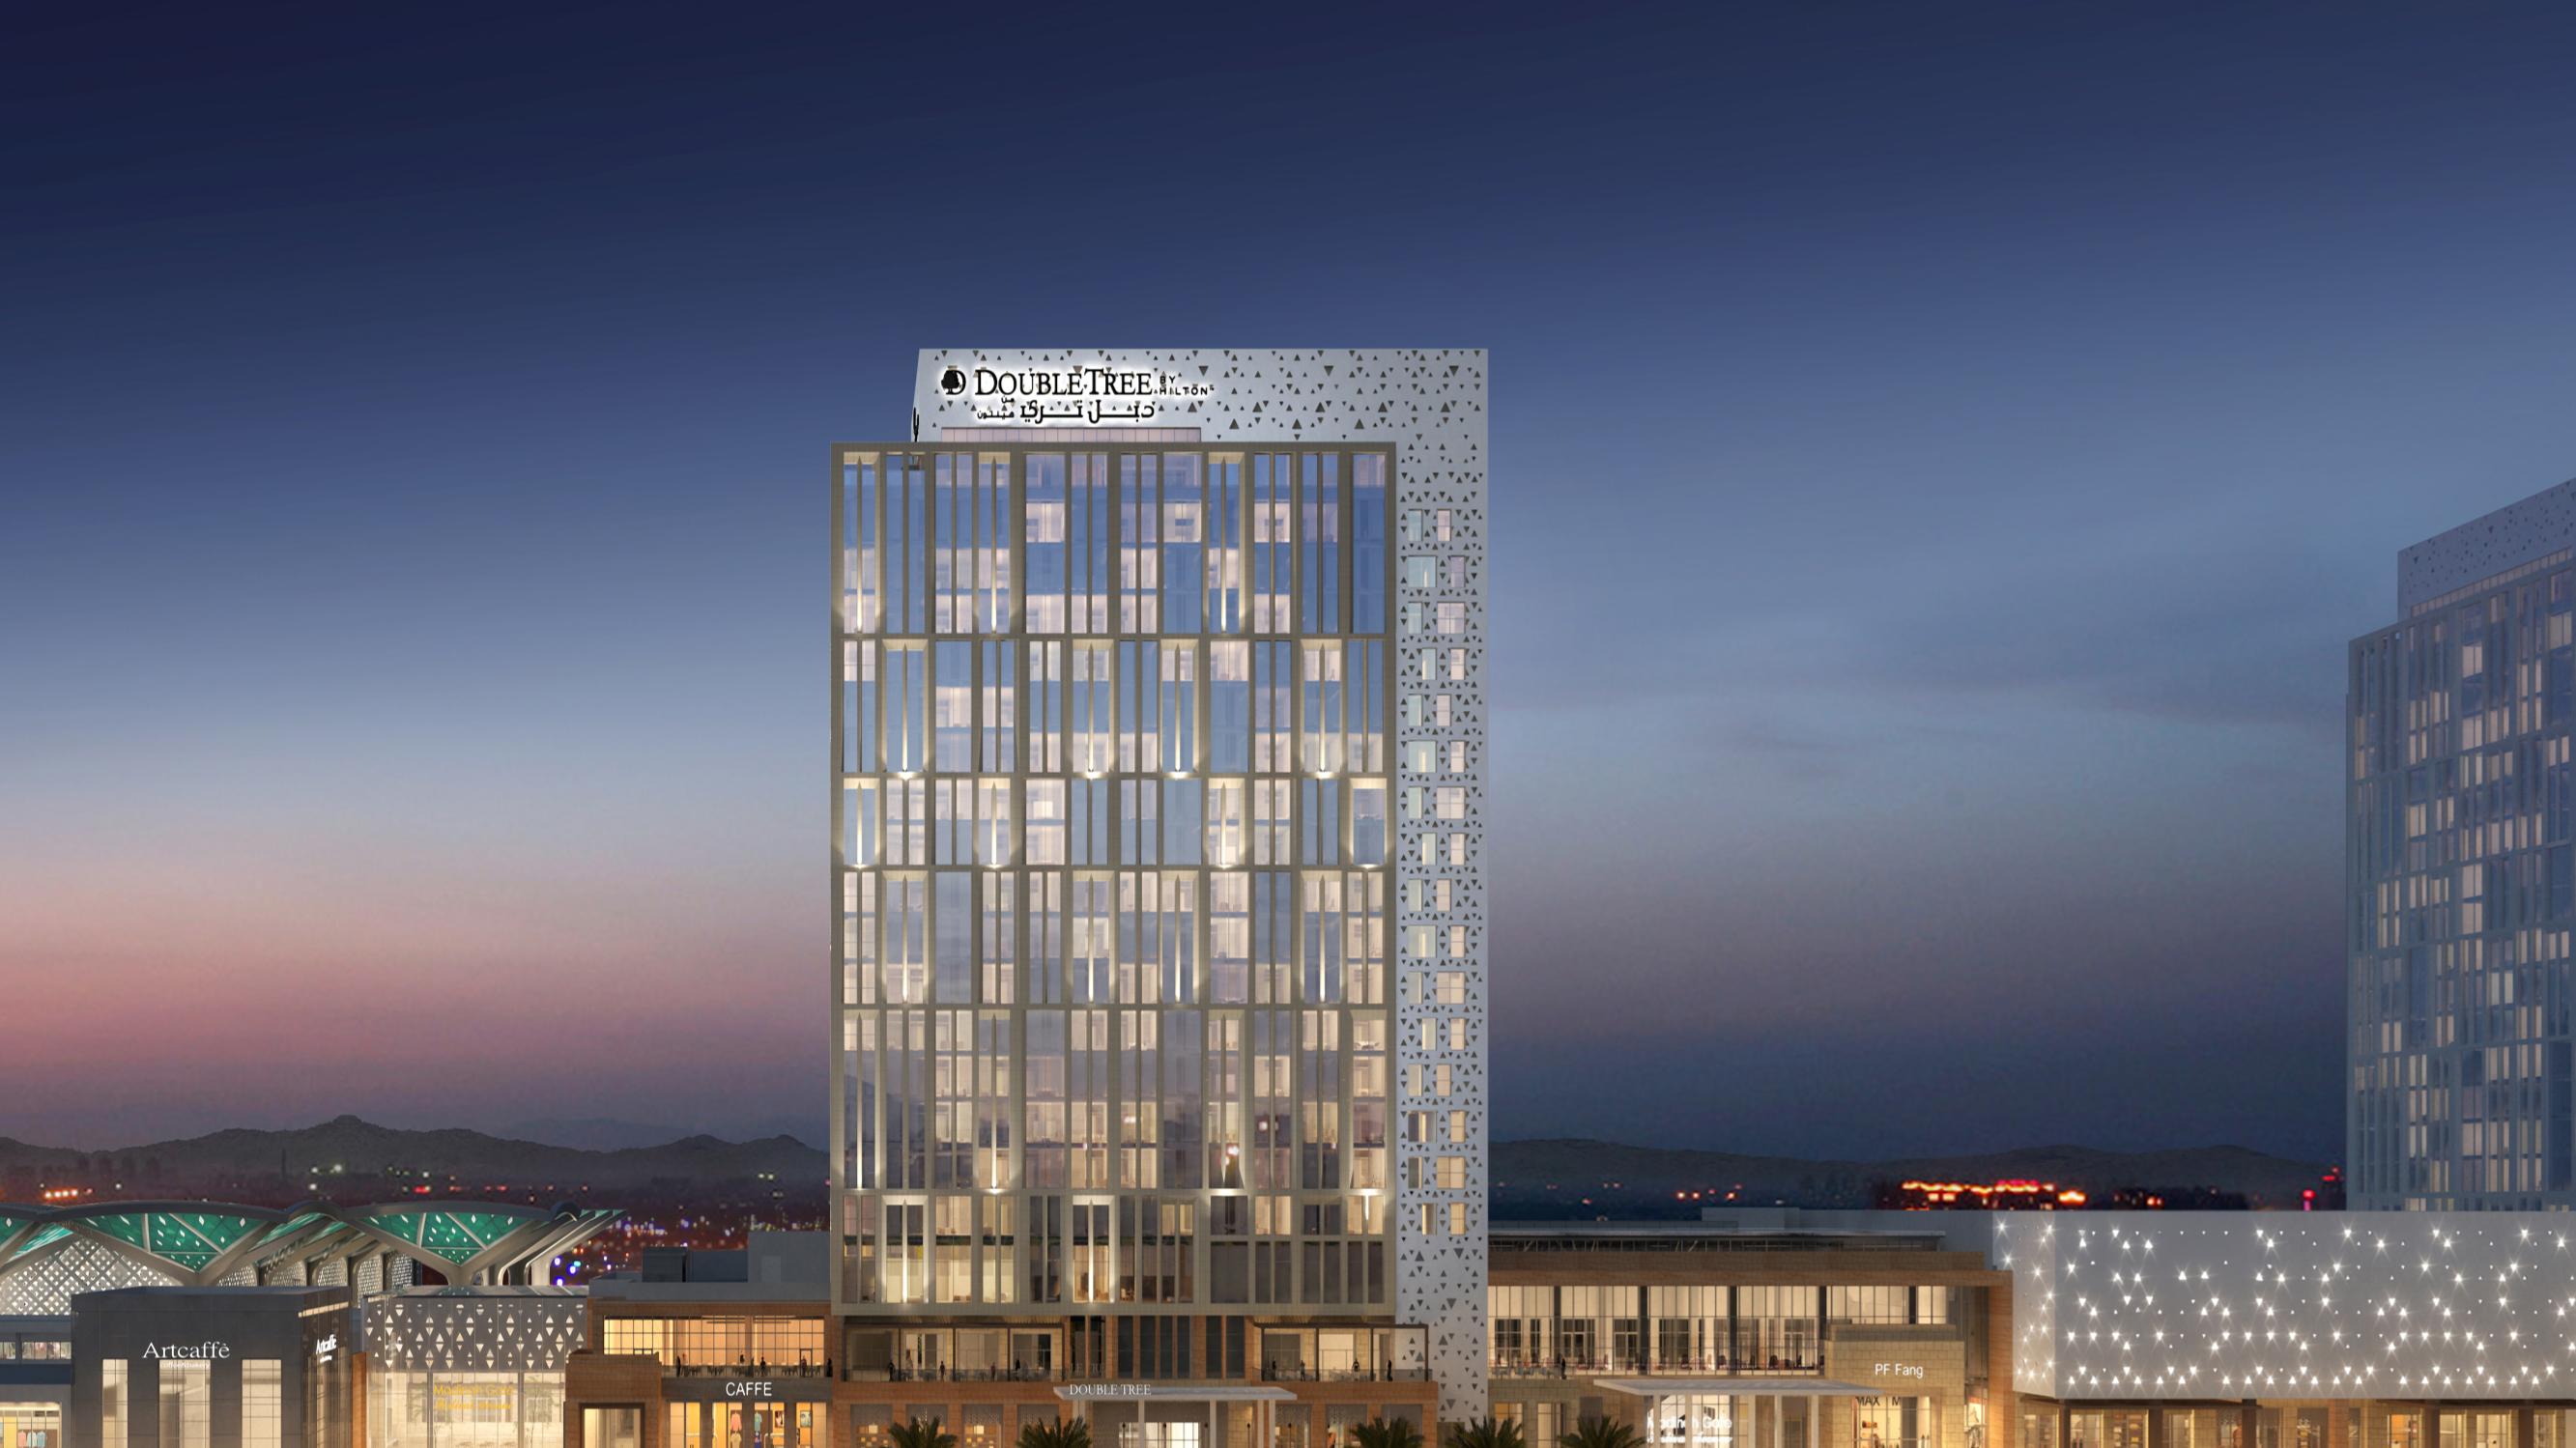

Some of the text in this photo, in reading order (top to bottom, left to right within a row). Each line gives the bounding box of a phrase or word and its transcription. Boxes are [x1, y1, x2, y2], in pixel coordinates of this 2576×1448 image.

[1875, 1363, 1924, 1379] PF Fang
[726, 1381, 772, 1397] CAFFE
[1070, 1384, 1152, 1396] DOUBLE TREE
